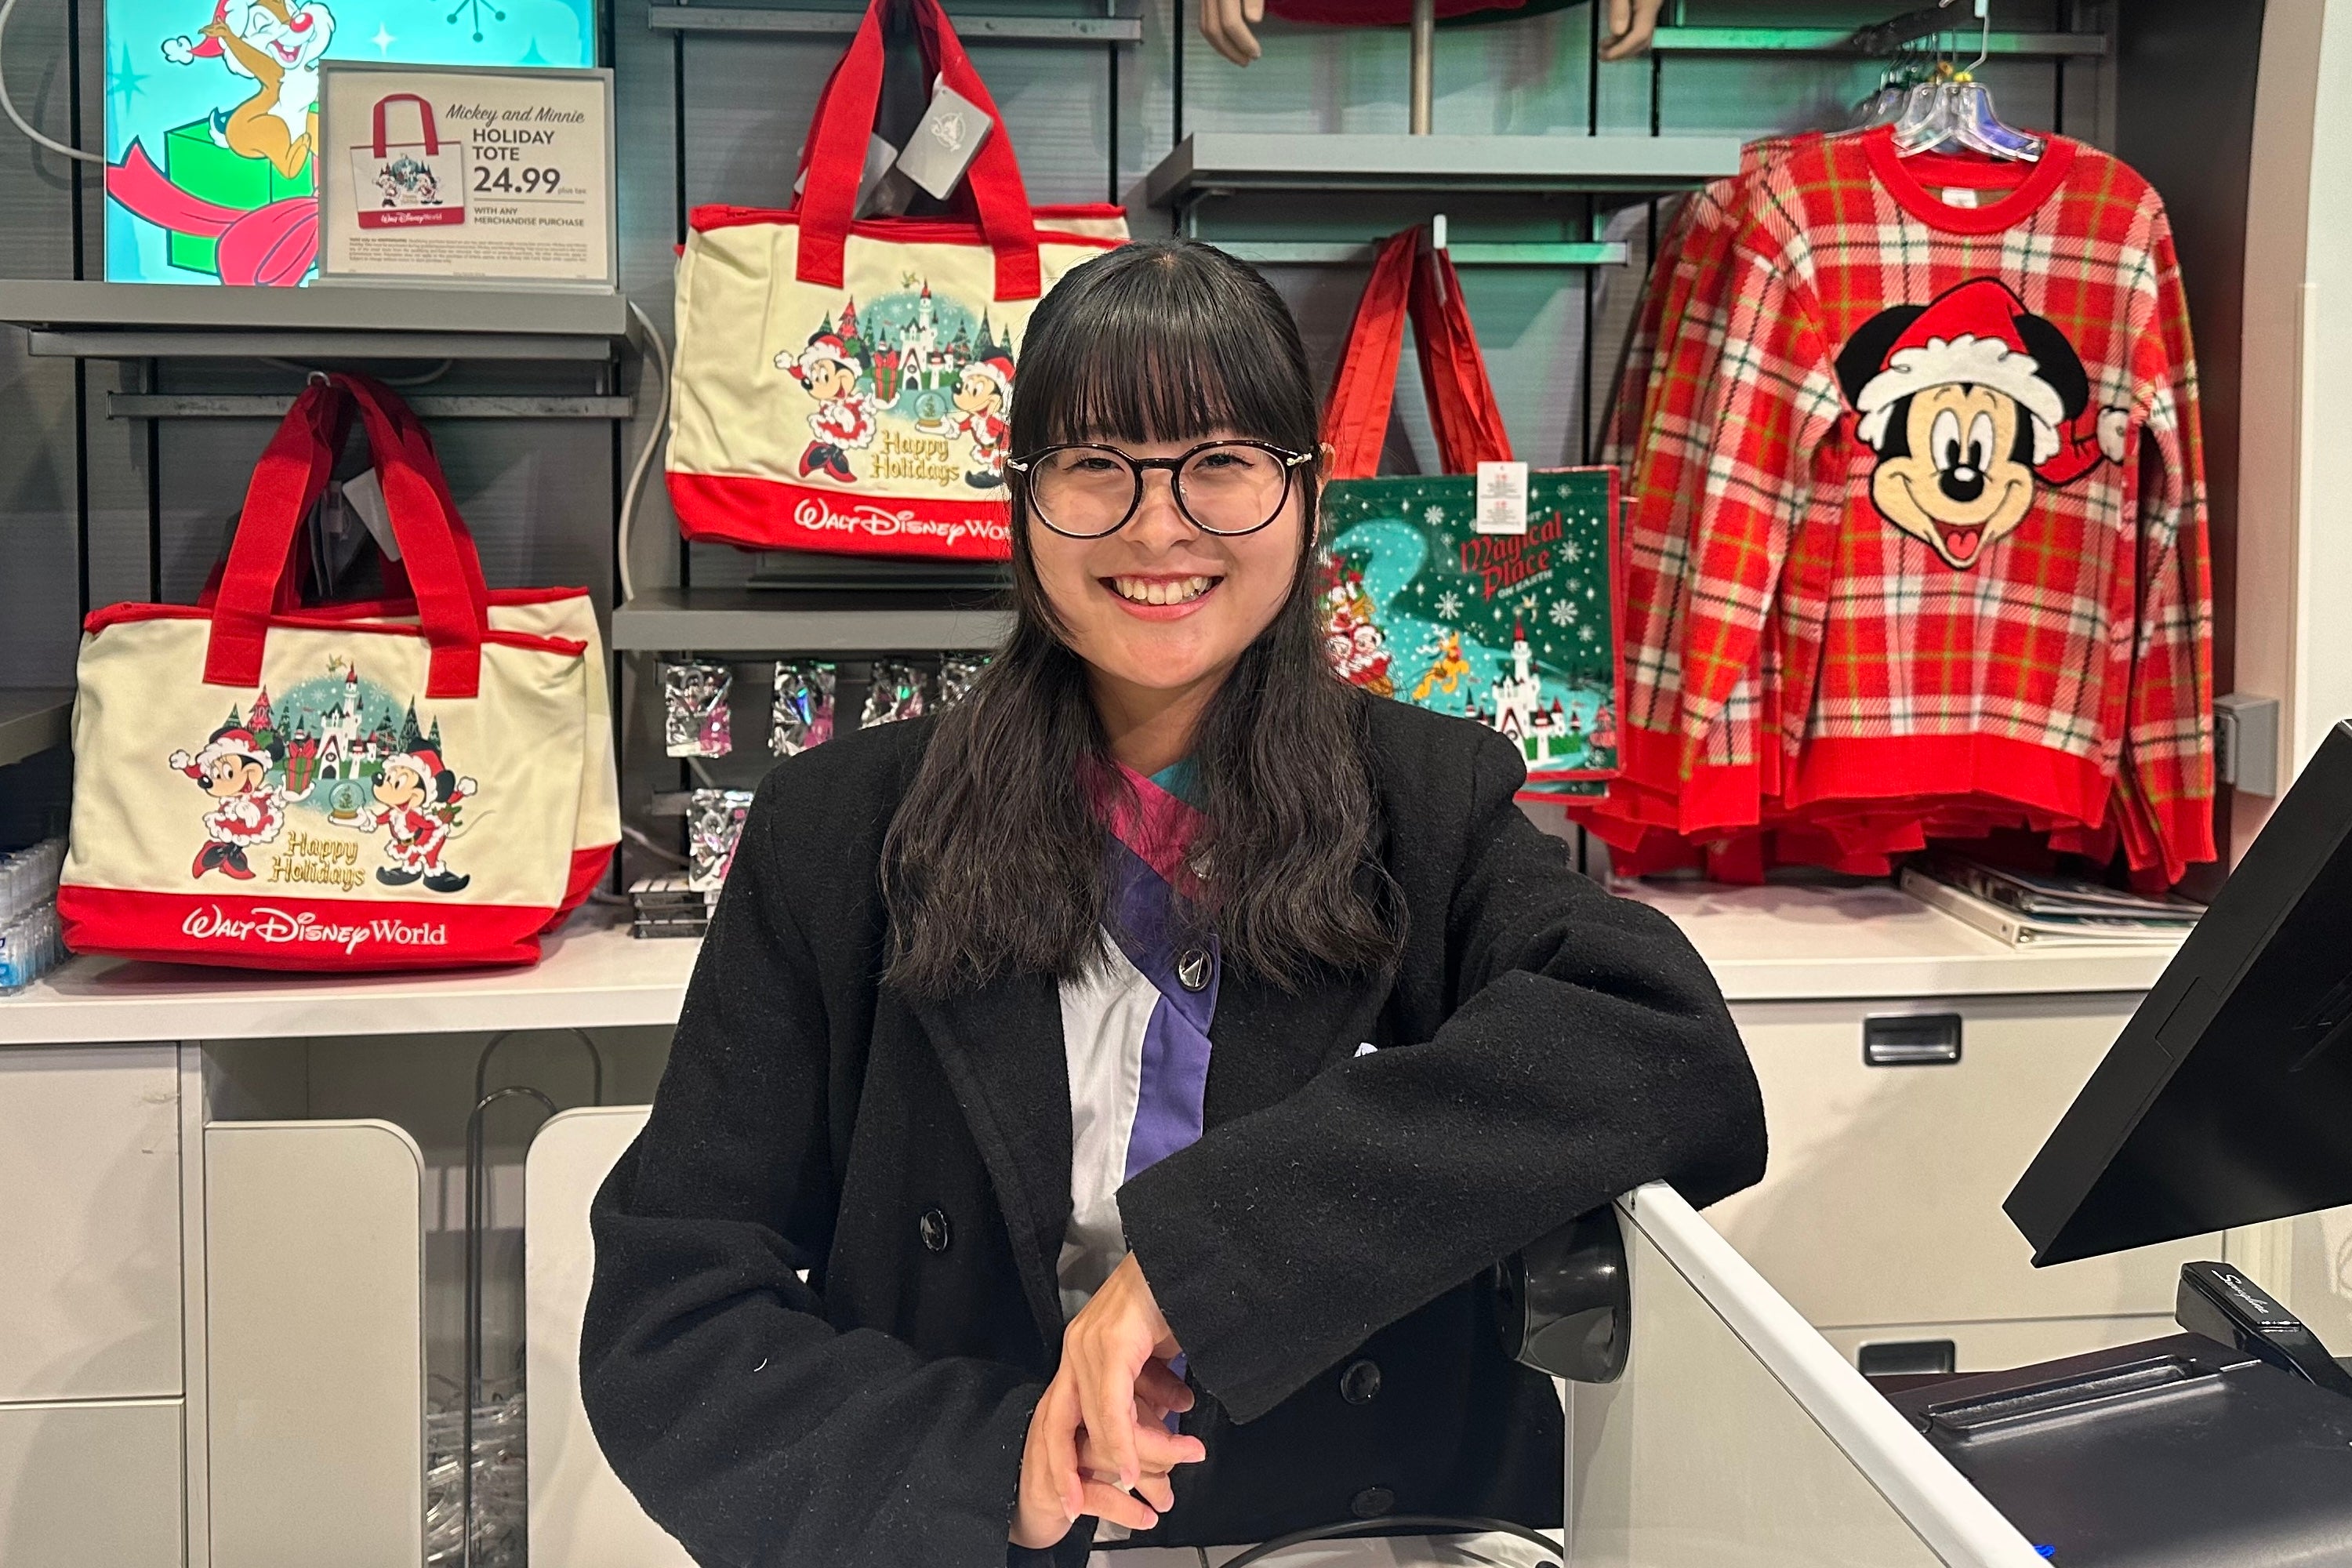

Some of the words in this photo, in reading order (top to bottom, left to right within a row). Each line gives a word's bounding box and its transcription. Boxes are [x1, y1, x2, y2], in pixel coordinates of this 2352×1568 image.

[445, 103, 497, 128] Mickey
[502, 107, 533, 122] and
[534, 107, 586, 123] Minnie
[473, 129, 555, 145] HOLIDAY
[472, 146, 520, 162] TOTE
[474, 166, 561, 194] 24.99
[474, 216, 537, 225] MERCHANDISE
[539, 218, 584, 227] PURCHASE
[881, 430, 949, 462] Happy
[870, 454, 960, 486] Holidays
[964, 519, 1011, 541] Wo
[1461, 511, 1563, 574] Magical
[1479, 550, 1551, 603] Place
[1497, 585, 1515, 600] ON
[1515, 568, 1553, 593] EARTH
[284, 830, 358, 865] Happy
[267, 855, 365, 892] Holidays
[370, 919, 448, 946] World
